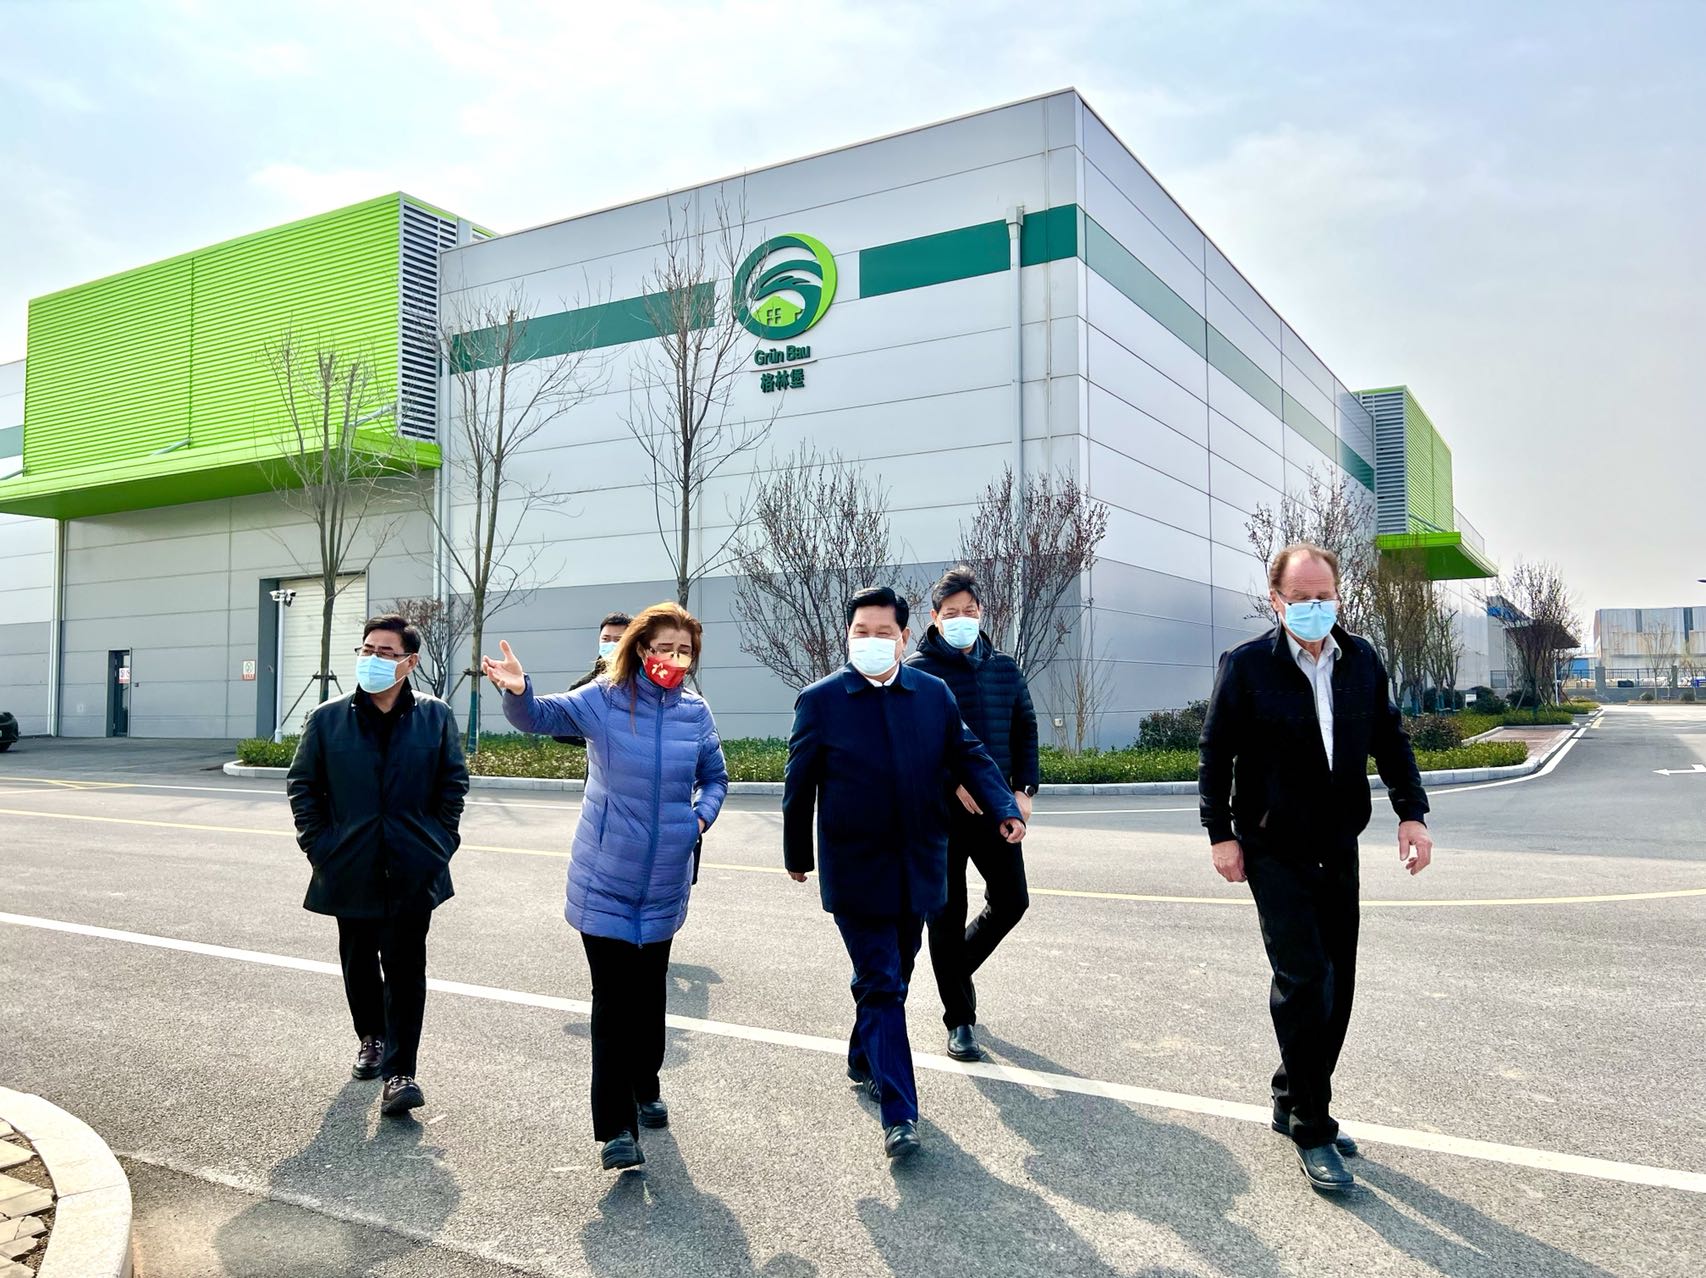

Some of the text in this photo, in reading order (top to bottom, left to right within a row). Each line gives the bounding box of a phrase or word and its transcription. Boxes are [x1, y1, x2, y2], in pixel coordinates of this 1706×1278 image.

[755, 345, 811, 366] Grün Bau
[761, 368, 805, 393] 格林堡
